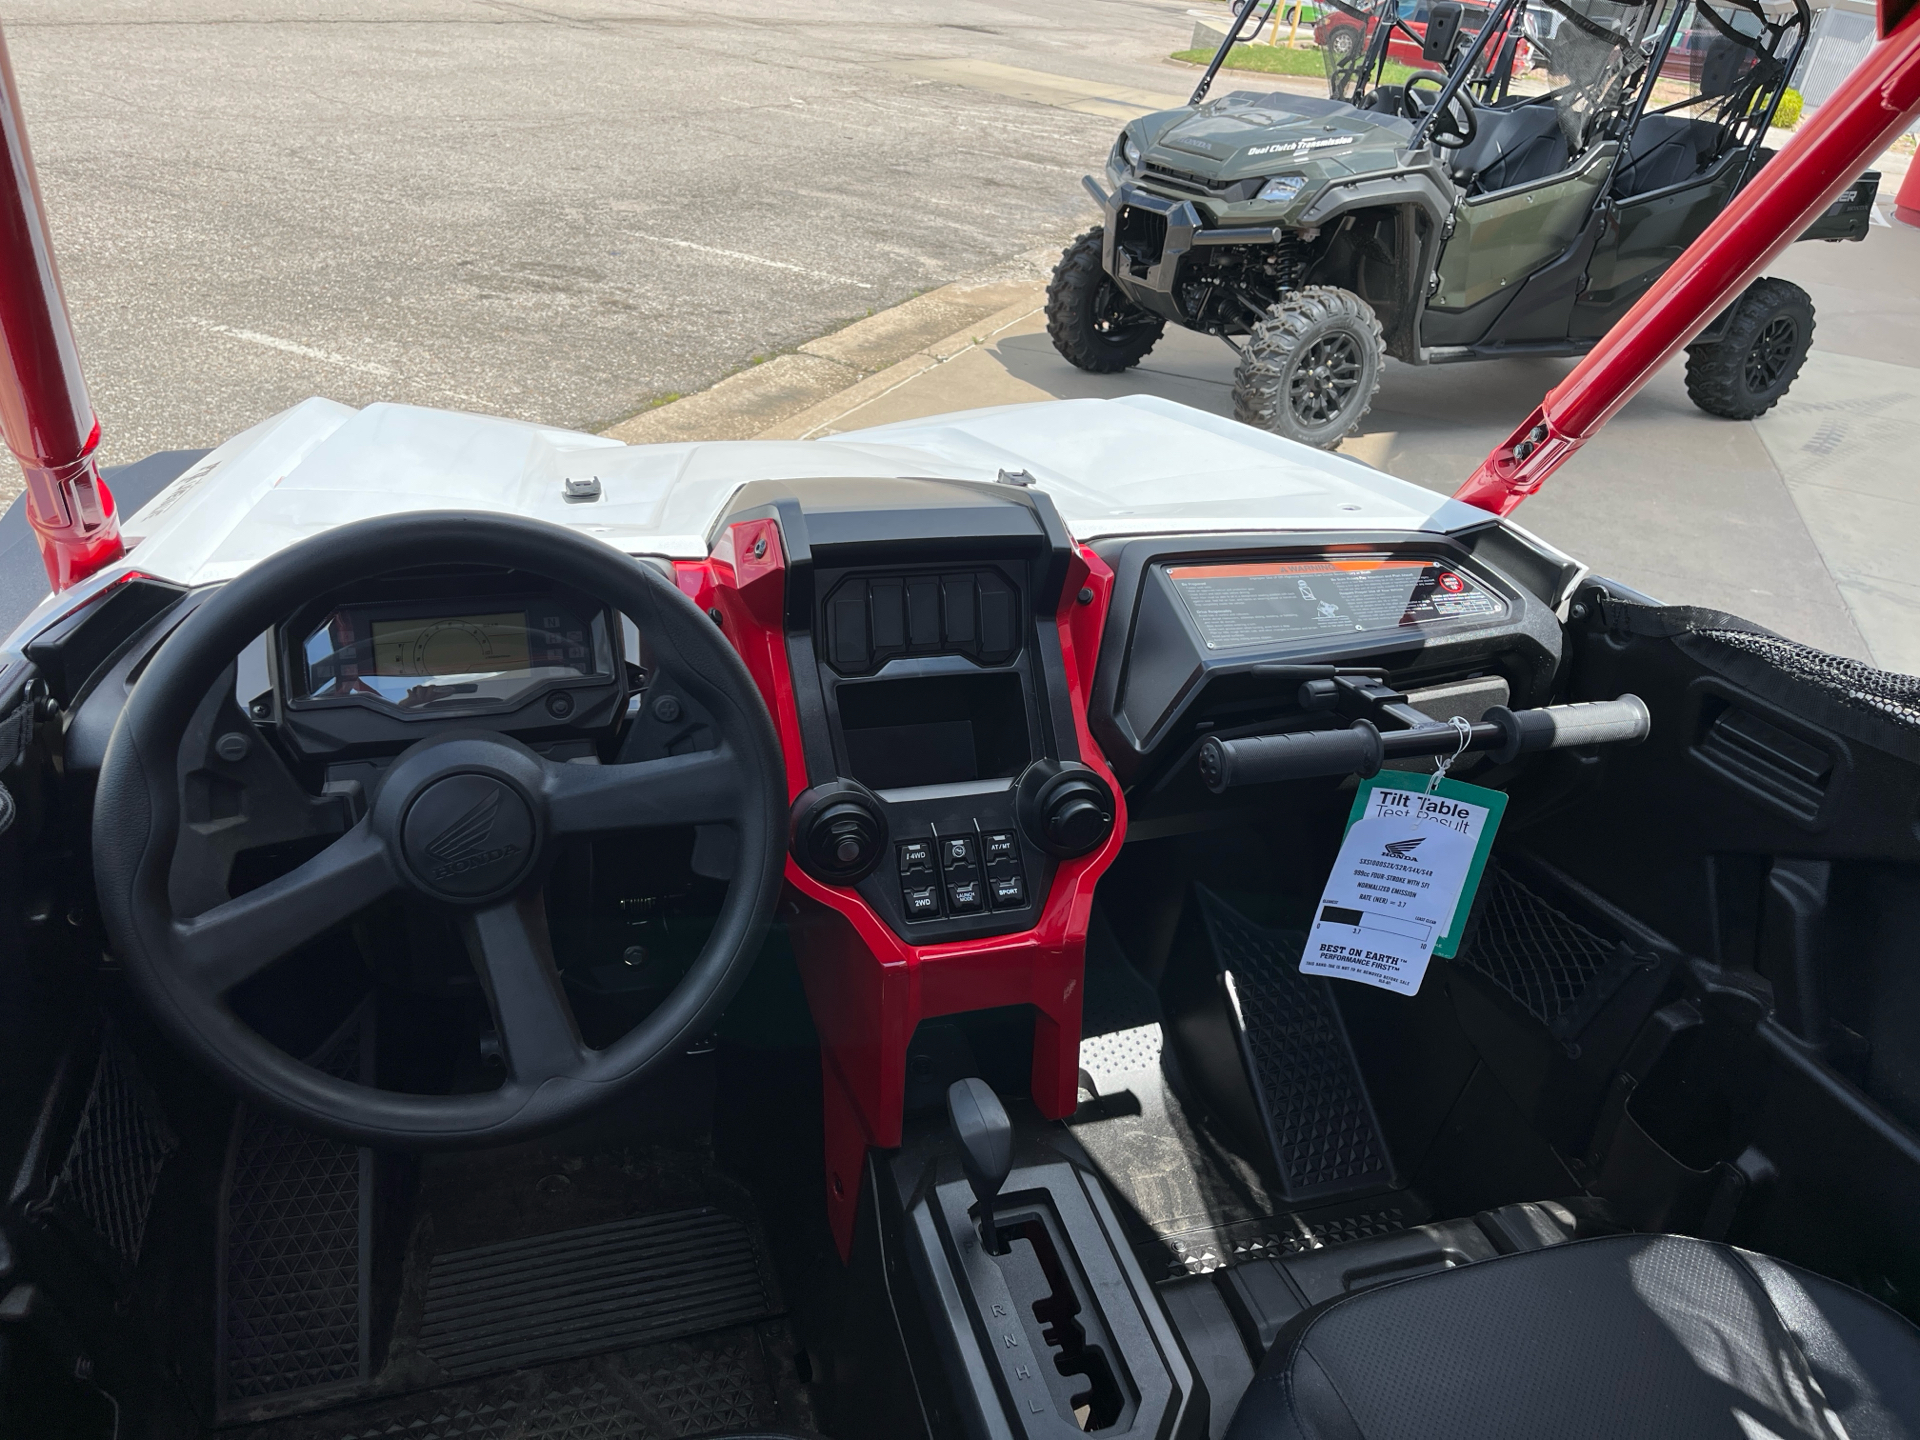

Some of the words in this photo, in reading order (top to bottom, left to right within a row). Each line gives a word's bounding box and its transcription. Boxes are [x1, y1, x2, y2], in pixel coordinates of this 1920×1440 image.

[1248, 146, 1269, 156] Dual
[1270, 143, 1297, 152] Clutch
[1297, 136, 1353, 150] Transmission
[1288, 564, 1335, 572] WARNING
[1376, 804, 1410, 818] Test
[1380, 791, 1410, 808] Tilt
[1417, 796, 1470, 819] Table
[432, 844, 522, 880] HONDA
[1381, 852, 1418, 862] HONDA
[1353, 869, 1370, 878] 999cc
[1370, 872, 1406, 884] FOUR-STROKE
[1407, 879, 1420, 887] WITH
[999, 888, 1018, 896] SPORT
[1356, 882, 1390, 893] NORMALIZED
[1391, 888, 1417, 898] EMISSION
[914, 898, 931, 907] 2WD
[1372, 896, 1388, 905] (NER)
[1320, 944, 1346, 954] BEST
[1348, 948, 1363, 957] ON
[1320, 953, 1370, 966] PERFORMANCE
[991, 1304, 1006, 1317] R
[1002, 1334, 1019, 1348] N
[1015, 1366, 1031, 1380] H
[1028, 1399, 1044, 1414] L
